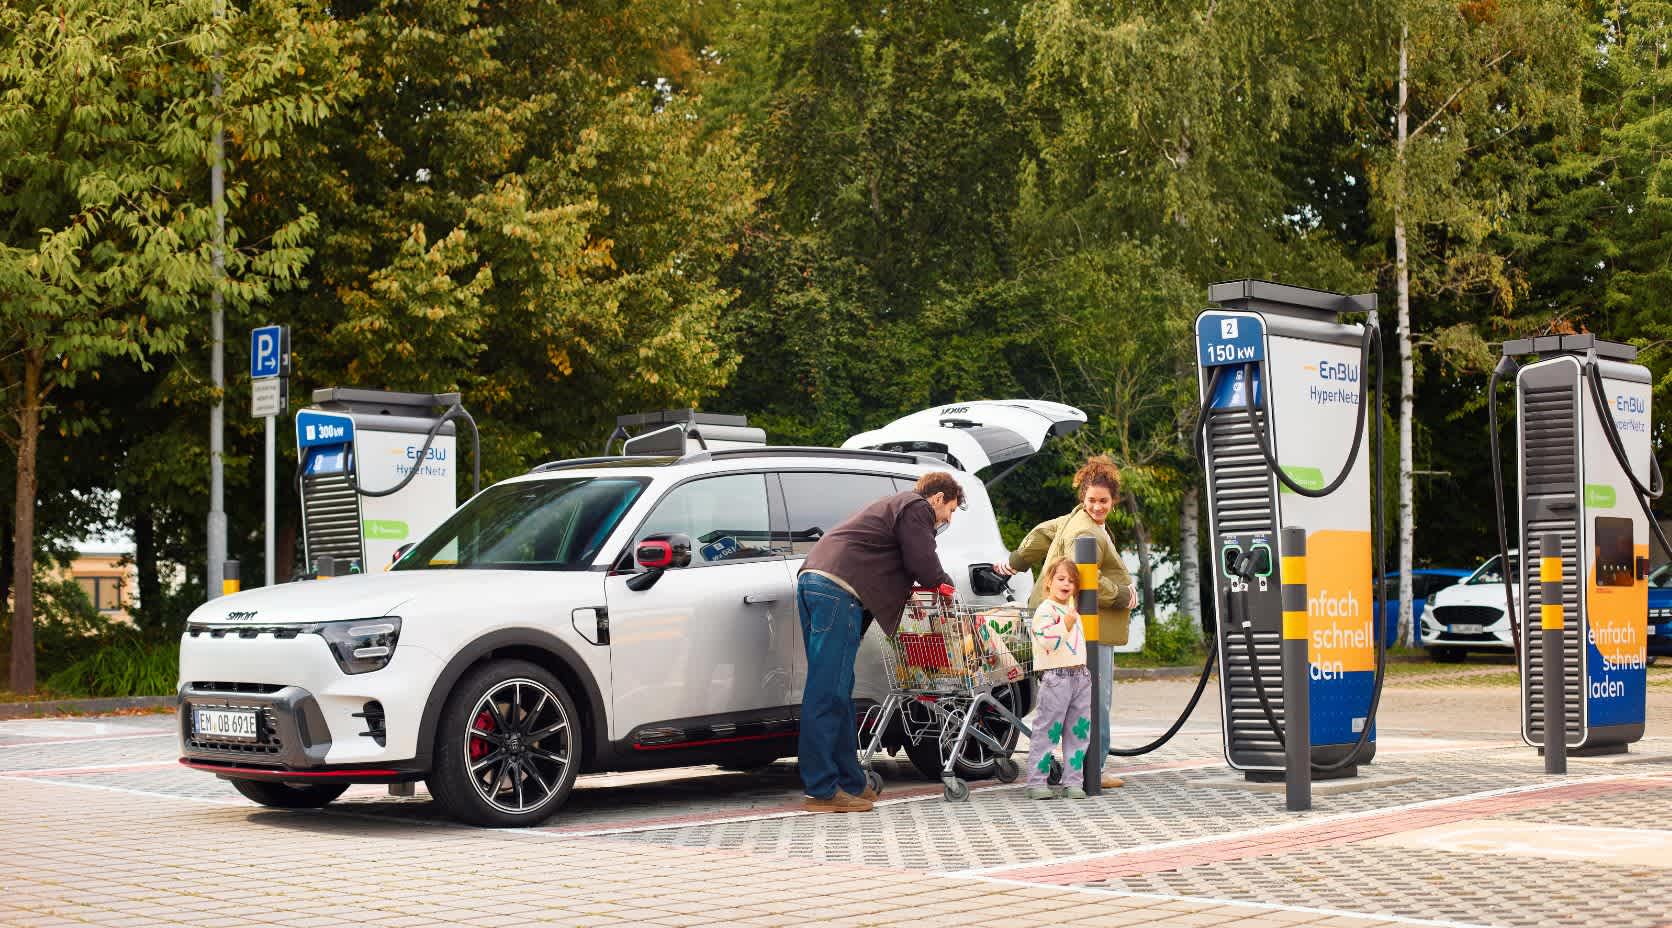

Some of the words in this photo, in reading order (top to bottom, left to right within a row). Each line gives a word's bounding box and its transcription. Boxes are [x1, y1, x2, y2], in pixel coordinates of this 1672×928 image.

[1226, 322, 1233, 335] 2
[257, 334, 273, 371] P
[1207, 343, 1235, 363] 150
[1319, 360, 1358, 383] EnBW
[1310, 385, 1359, 405] HyperNetz
[1617, 395, 1645, 414] EnBW
[318, 424, 334, 439] 300
[1308, 589, 1359, 617] nfach
[225, 610, 258, 621] smart
[1312, 620, 1373, 649] schnell
[1588, 620, 1636, 645] einfach
[1310, 653, 1344, 681] den
[1602, 647, 1646, 671] schnell
[1588, 674, 1625, 699] laden
[200, 713, 212, 731] EM
[218, 714, 230, 733] OB
[232, 715, 257, 734] 691E
